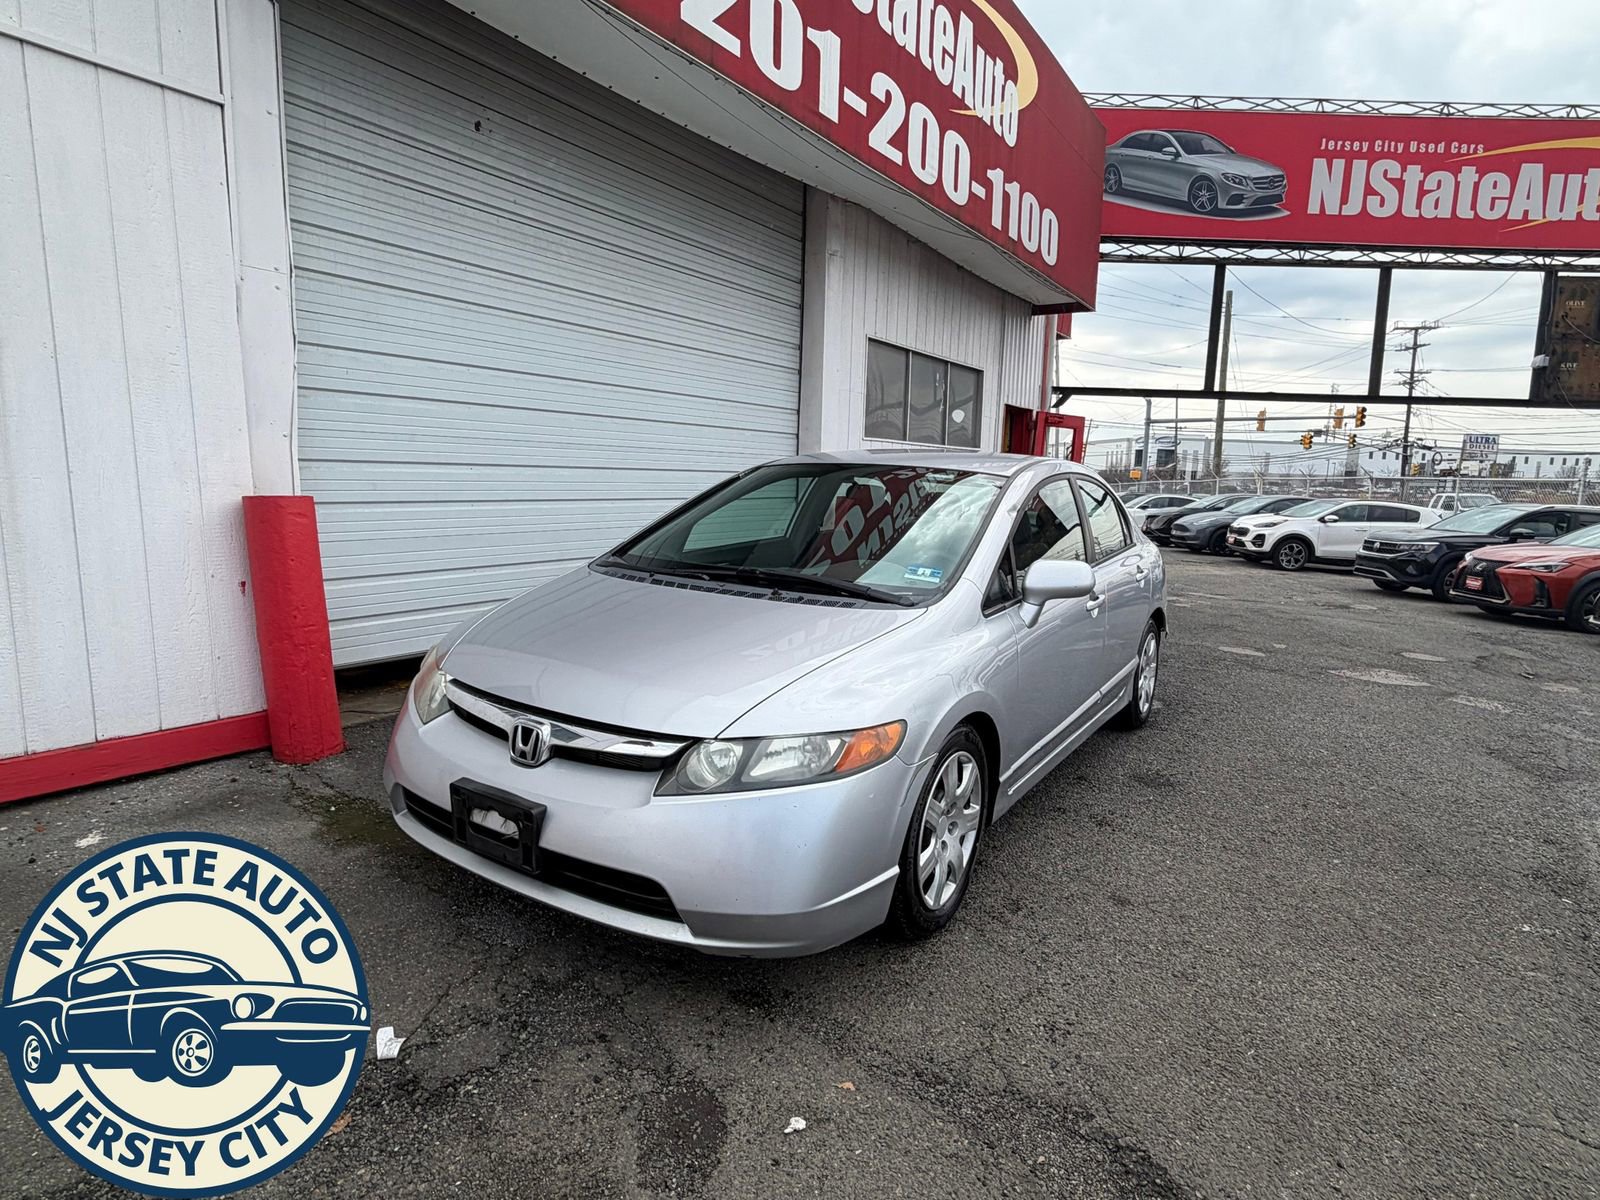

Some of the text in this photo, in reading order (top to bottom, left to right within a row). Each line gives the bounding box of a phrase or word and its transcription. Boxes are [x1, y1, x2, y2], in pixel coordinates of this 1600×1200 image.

[852, 0, 1019, 147] ateAuto
[1320, 138, 1484, 154] Jersey City Used Cars
[1469, 436, 1496, 444] ULTRA
